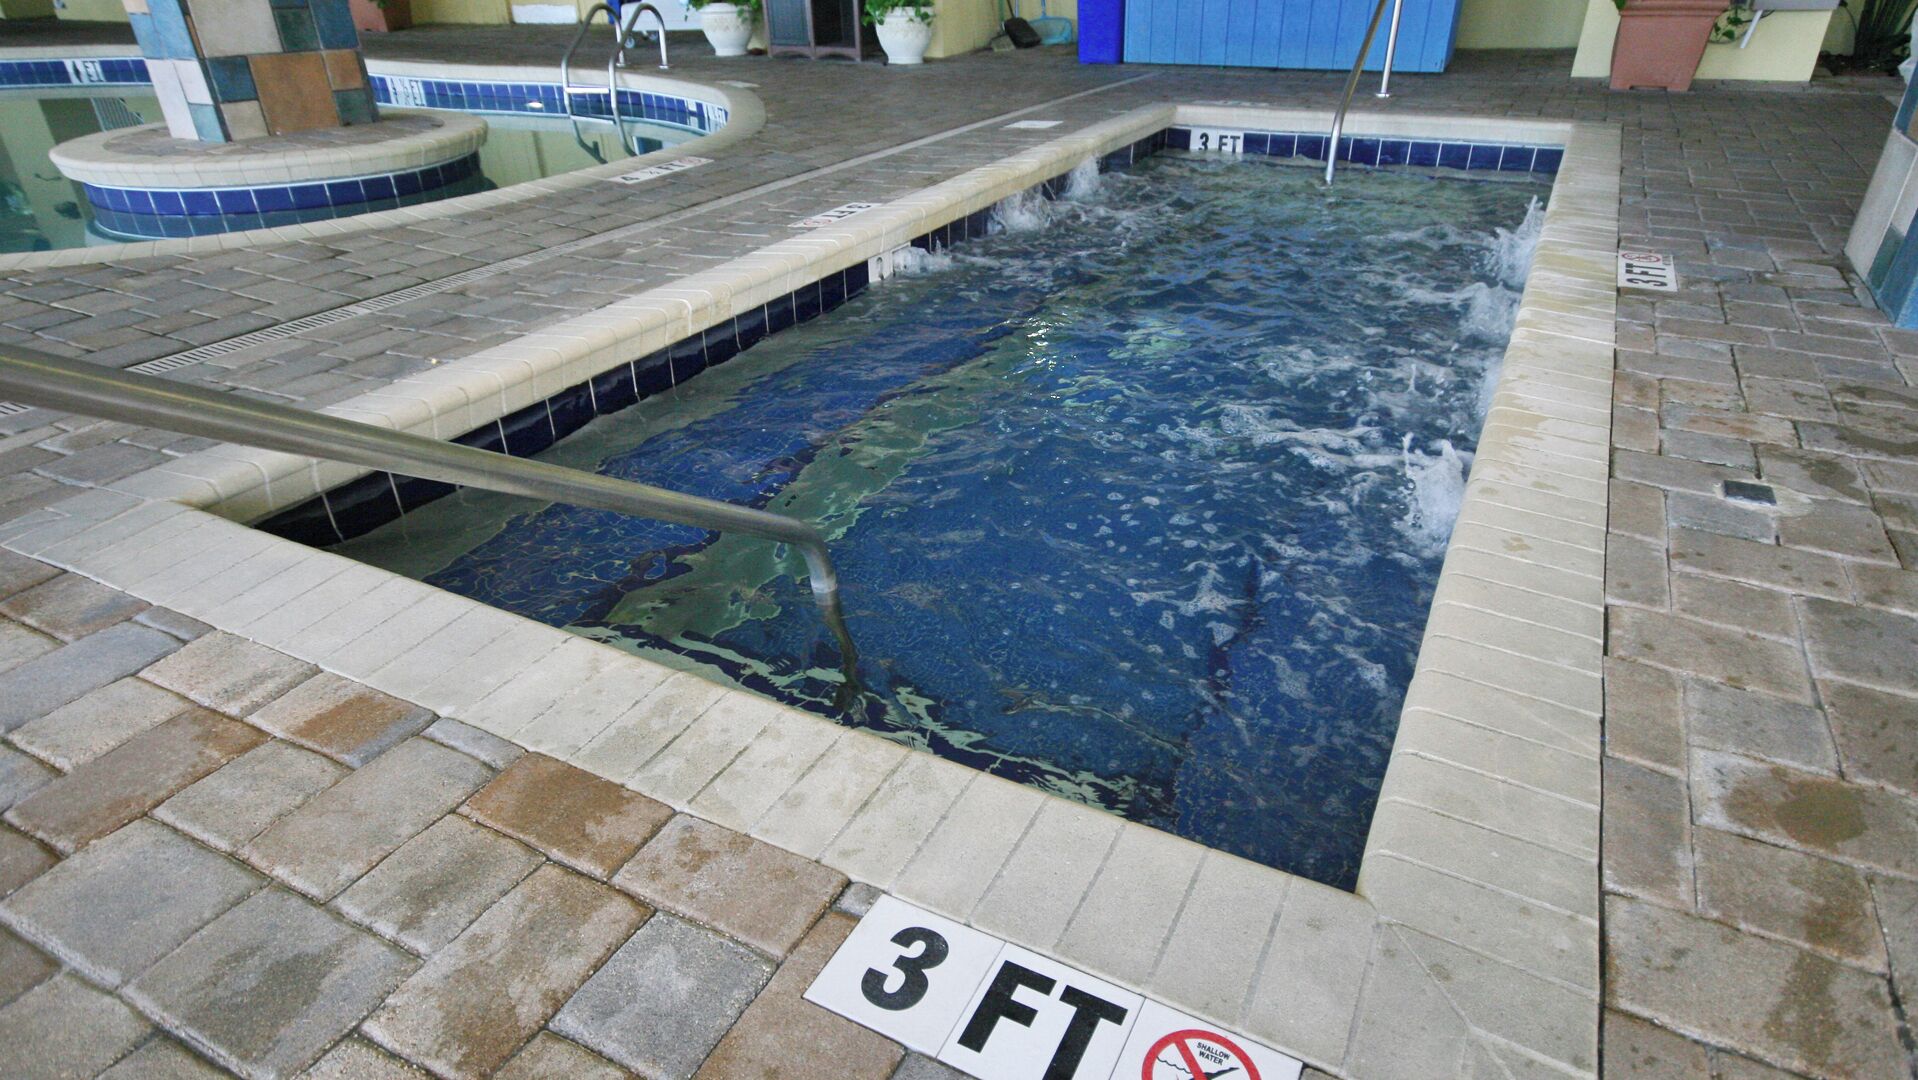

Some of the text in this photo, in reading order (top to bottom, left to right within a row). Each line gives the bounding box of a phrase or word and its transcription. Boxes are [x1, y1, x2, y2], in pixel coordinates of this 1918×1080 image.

[1199, 132, 1241, 153] 3 FT
[821, 210, 857, 219] FT
[1625, 262, 1668, 287] 3 FT
[860, 926, 1129, 1080] 3 FT
[1196, 1041, 1231, 1061] SHALLOW
[1199, 1050, 1224, 1067] WATER
